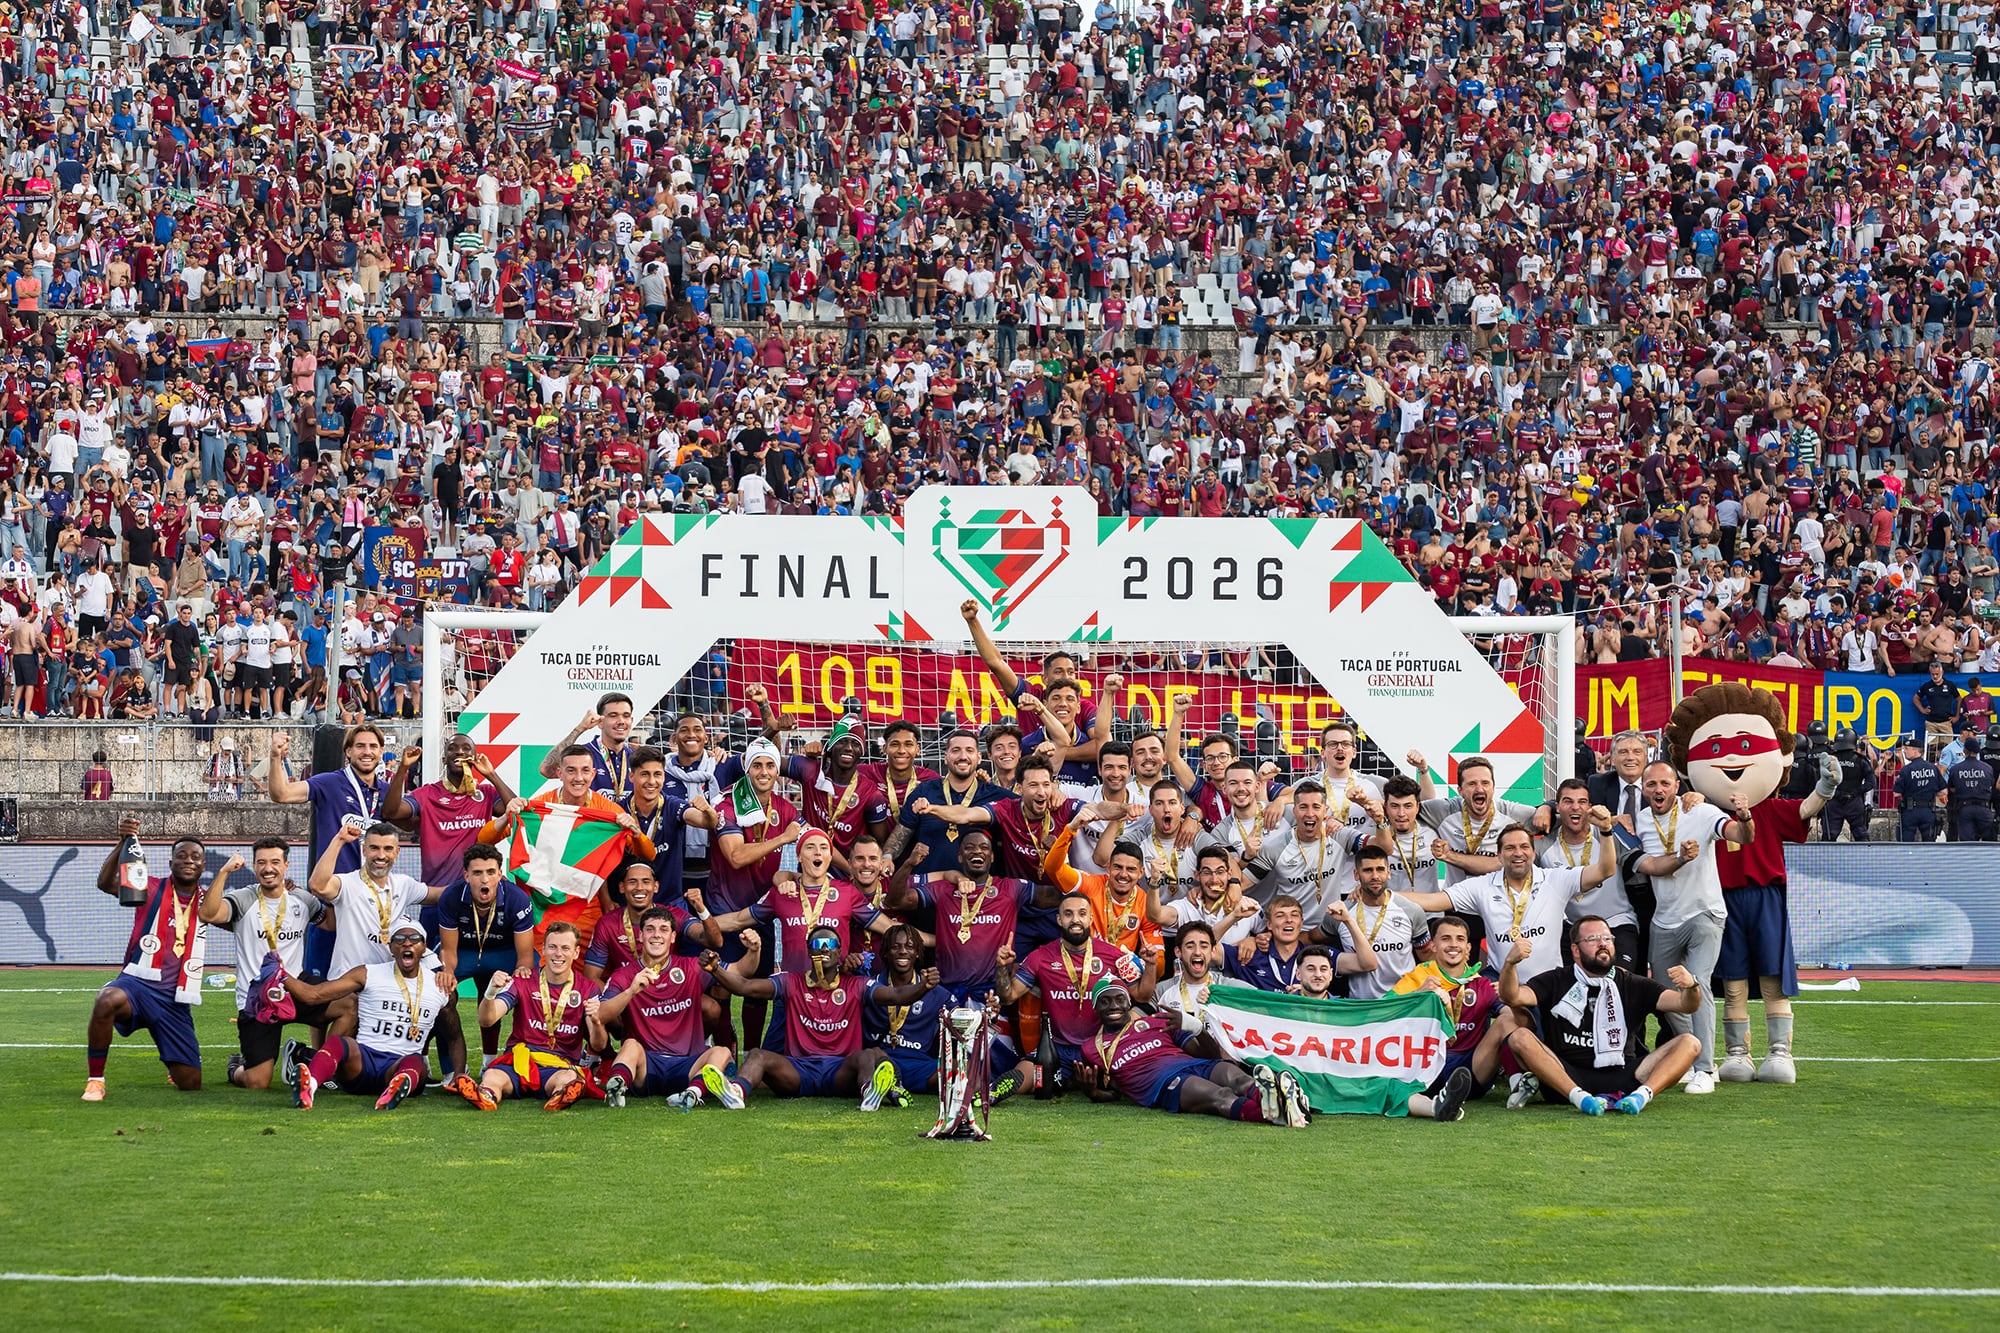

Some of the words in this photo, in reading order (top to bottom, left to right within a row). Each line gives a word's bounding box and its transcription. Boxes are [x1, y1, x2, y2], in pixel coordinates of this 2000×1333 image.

[1726, 29, 1734, 41] 7
[657, 85, 668, 96] 30
[619, 221, 632, 233] 22
[393, 560, 416, 578] SC
[441, 561, 468, 579] UT
[701, 553, 889, 599] FINAL
[1123, 556, 1283, 601] 2026
[402, 584, 413, 597] 19
[540, 653, 572, 664] TACA
[576, 653, 591, 665] DE
[596, 653, 661, 666] PORTUGAL
[1340, 659, 1372, 671] TACA
[1376, 660, 1392, 671] DE
[1396, 660, 1462, 672] PORTUGAL
[567, 667, 634, 681] GENERALI
[1367, 674, 1435, 687] GENERALI
[567, 681, 634, 691] TRANQUILIDADE
[778, 653, 903, 717] 109
[1368, 688, 1435, 697] TRANQUILIDADE
[1911, 768, 1936, 780] POLÍCIA
[1958, 768, 1986, 779] POLÍCIA
[813, 801, 852, 832] VALORO
[1389, 858, 1436, 871] ALURO
[786, 917, 840, 929] VALURO
[949, 914, 1001, 925] VAOURO
[256, 929, 303, 941] VOUR
[1494, 926, 1546, 943] VAURO
[382, 1000, 431, 1018] BELG
[641, 998, 693, 1018] VALOURO
[528, 1018, 579, 1034] VALURO
[799, 1014, 849, 1032] VALOURO
[1112, 1038, 1162, 1070] VALOURO
